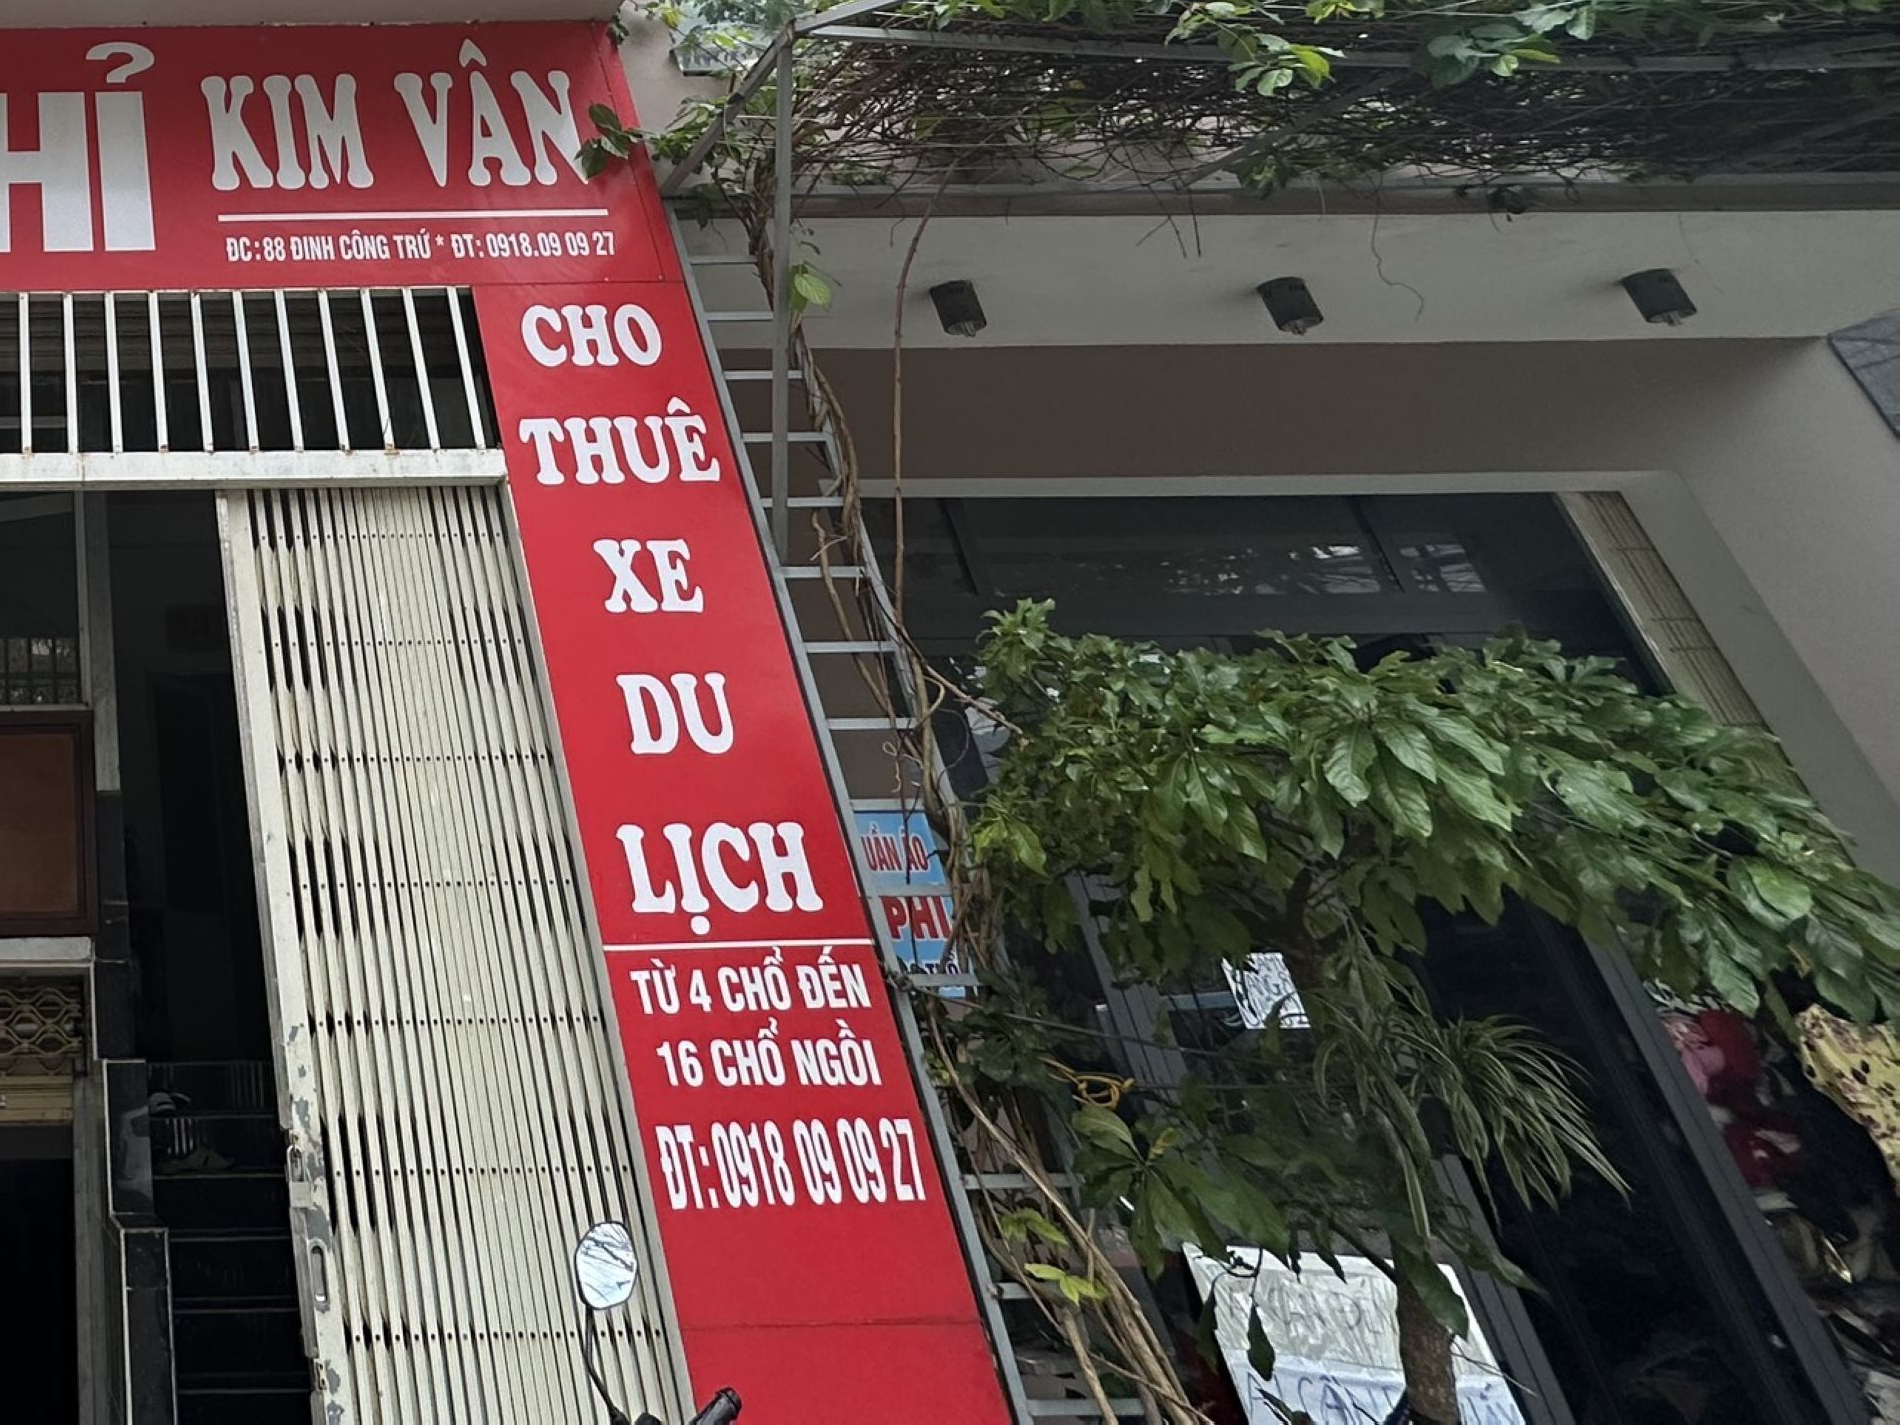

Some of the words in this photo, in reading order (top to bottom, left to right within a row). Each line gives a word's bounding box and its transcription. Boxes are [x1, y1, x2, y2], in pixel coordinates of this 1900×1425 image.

[200, 72, 375, 192] KIM
[394, 38, 590, 187] VÂN
[289, 235, 336, 261] ĐINH
[338, 229, 391, 260] CÔNG
[393, 228, 432, 260] TRỨ
[565, 230, 591, 257] 09
[592, 230, 616, 257] 27
[520, 303, 663, 367] CHO
[518, 396, 721, 485] THUÊ
[592, 537, 705, 614] XE
[615, 672, 735, 755] DU
[615, 821, 824, 936] LỊCH
[630, 958, 681, 1015] TỪ
[689, 969, 713, 1012] 4
[795, 945, 873, 1009] ĐẾN
[656, 1039, 704, 1087] 16
[790, 1018, 883, 1086] NGỒI
[793, 1118, 842, 1205] 09
[836, 1117, 888, 1204] 09
[878, 1117, 927, 1202] 27
